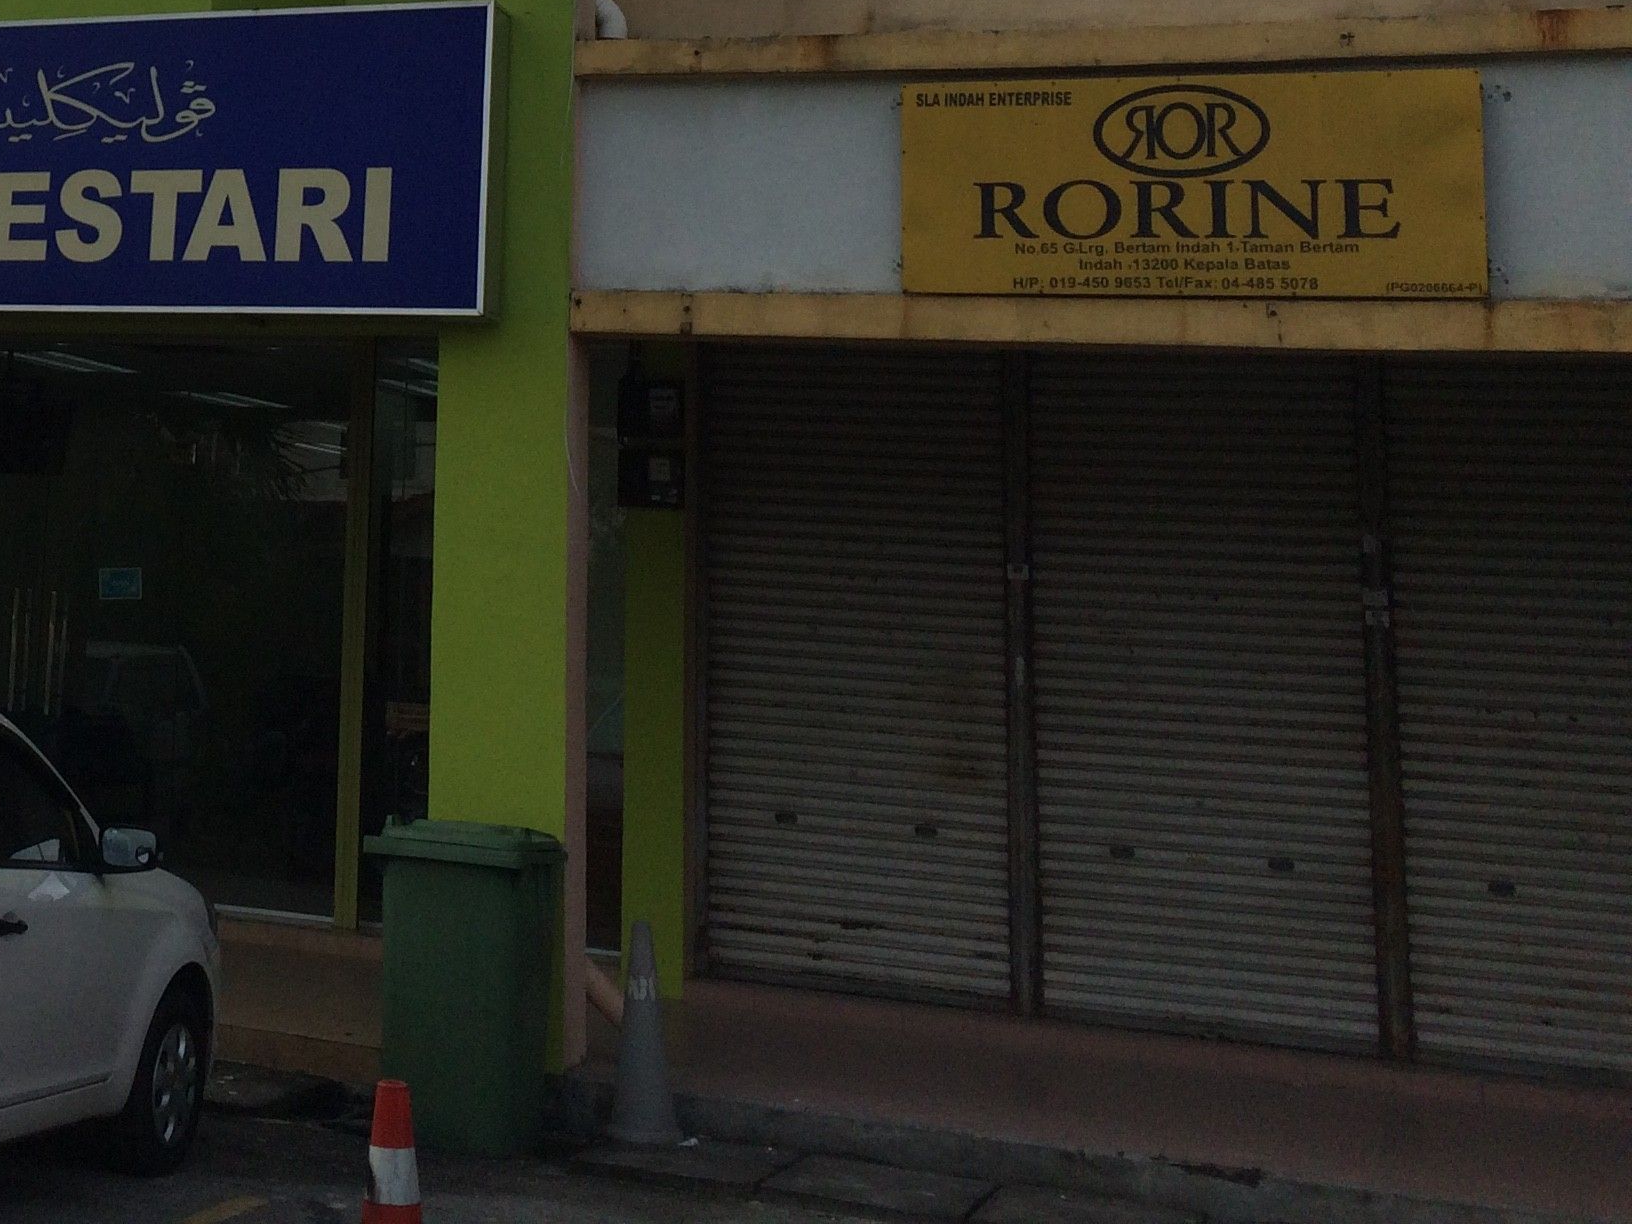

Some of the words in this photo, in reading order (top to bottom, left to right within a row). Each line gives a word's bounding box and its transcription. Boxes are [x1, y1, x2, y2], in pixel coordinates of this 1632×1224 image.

[916, 93, 940, 107] SLA
[944, 93, 985, 107] INDAH
[989, 91, 1073, 107] ENTERPRISE
[973, 177, 1400, 240] RORINE
[1115, 242, 1170, 254] Bertam
[1176, 241, 1220, 253] Indah
[1300, 241, 1360, 253] Bertam
[1079, 258, 1122, 270] Indah
[1184, 258, 1238, 273] Kepala
[1244, 258, 1291, 270] Batas
[1013, 277, 1045, 290] H/P:
[1049, 277, 1109, 289] 019-450
[1156, 277, 1217, 290] Tel/Fax:
